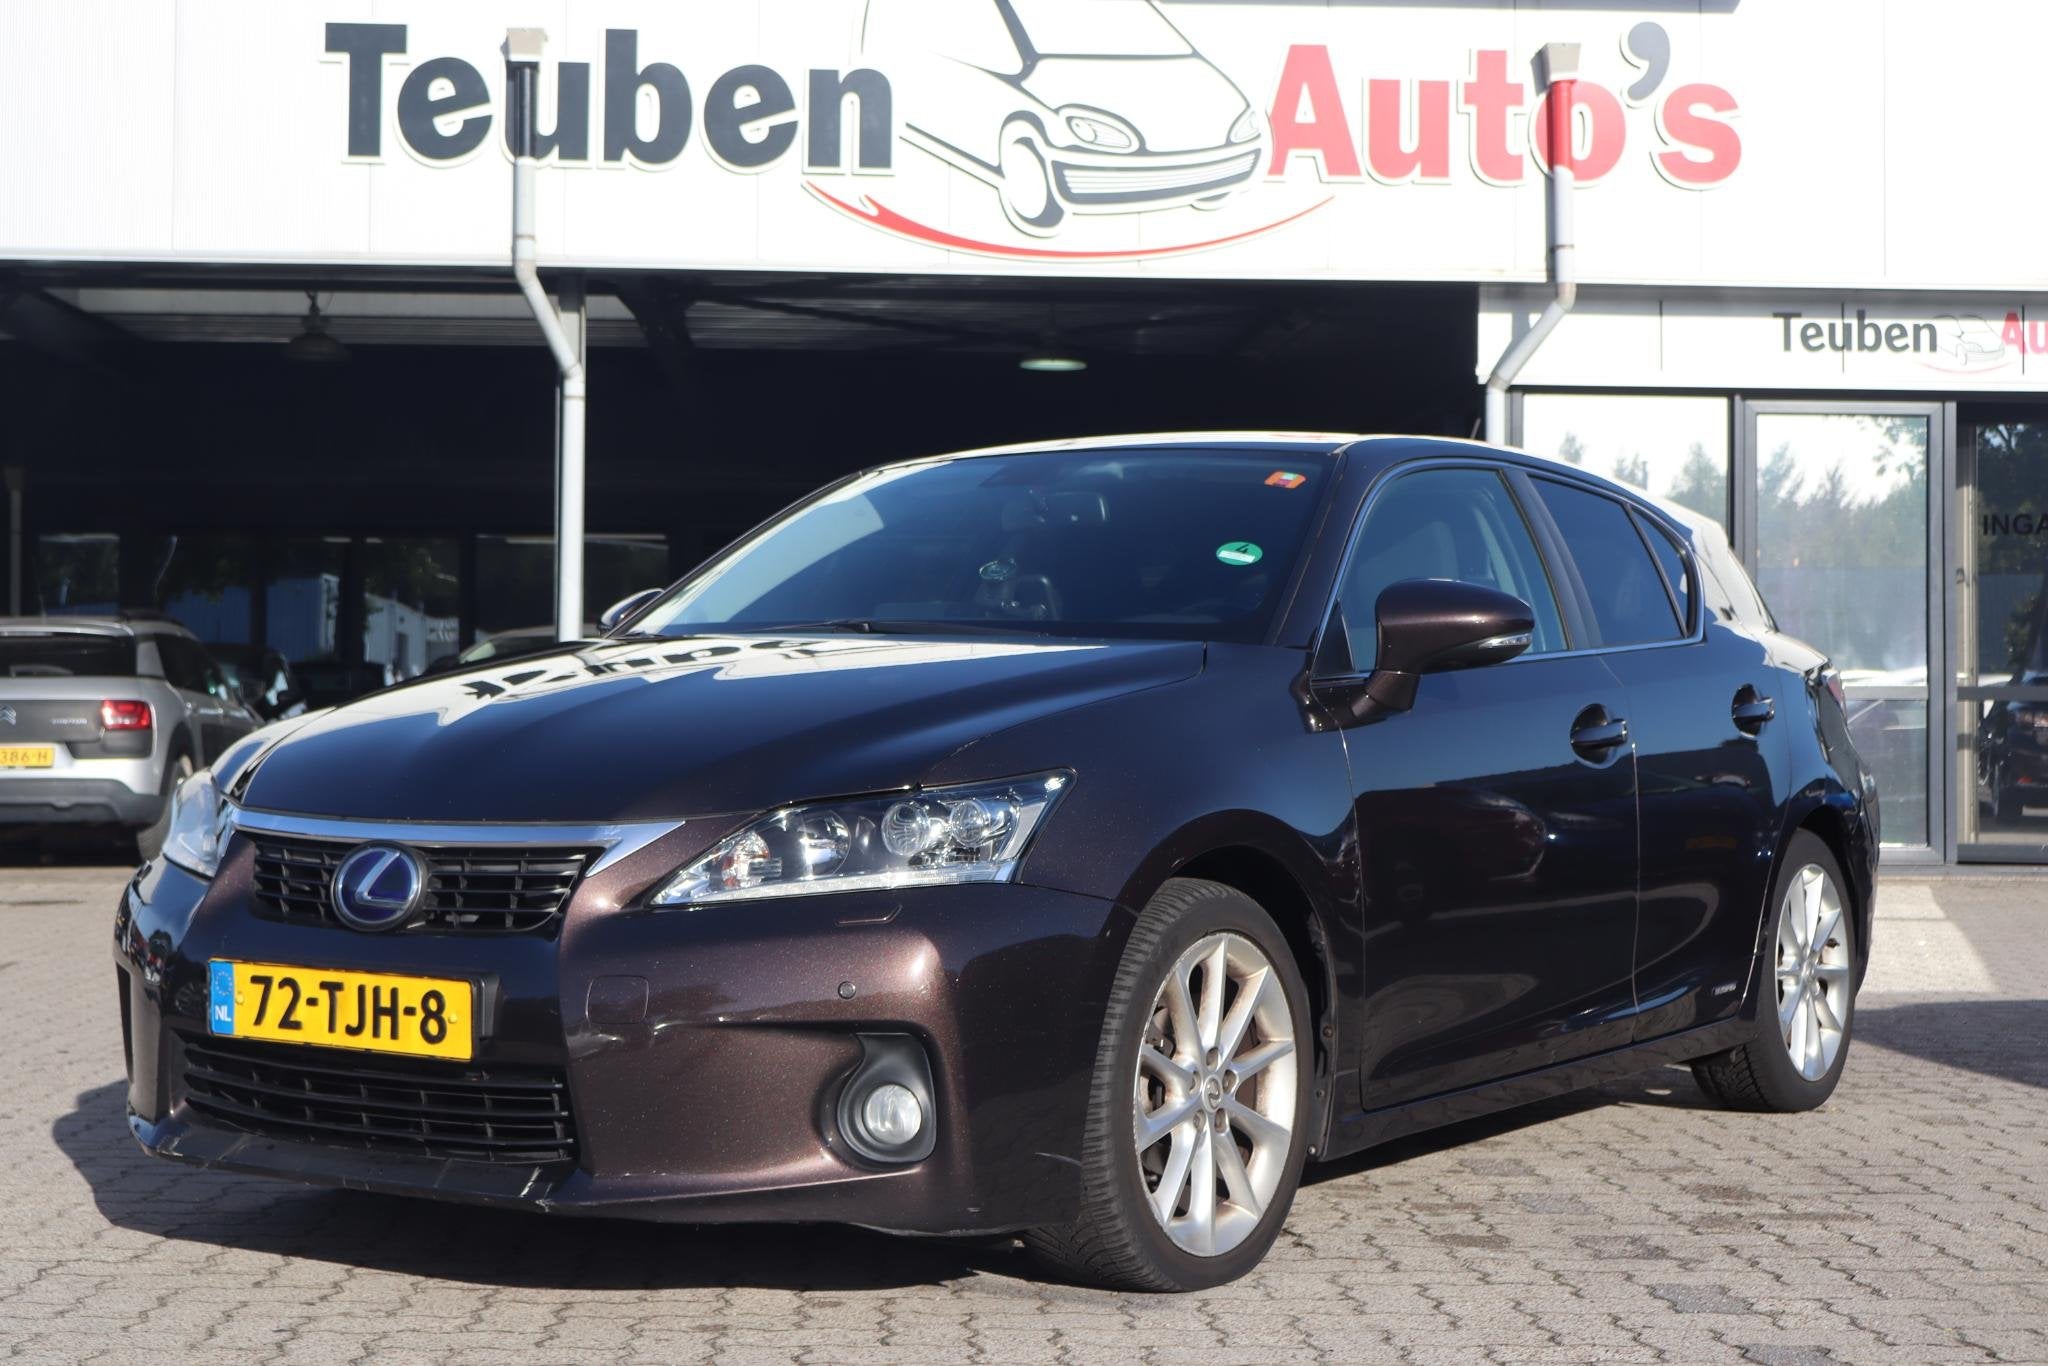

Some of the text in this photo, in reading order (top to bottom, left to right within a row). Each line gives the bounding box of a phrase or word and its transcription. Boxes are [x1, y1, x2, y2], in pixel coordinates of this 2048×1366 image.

[324, 21, 1742, 183] Teuben Auto's
[1772, 309, 1938, 353] Teuben
[213, 974, 448, 1045] NL 72-TJH-8
